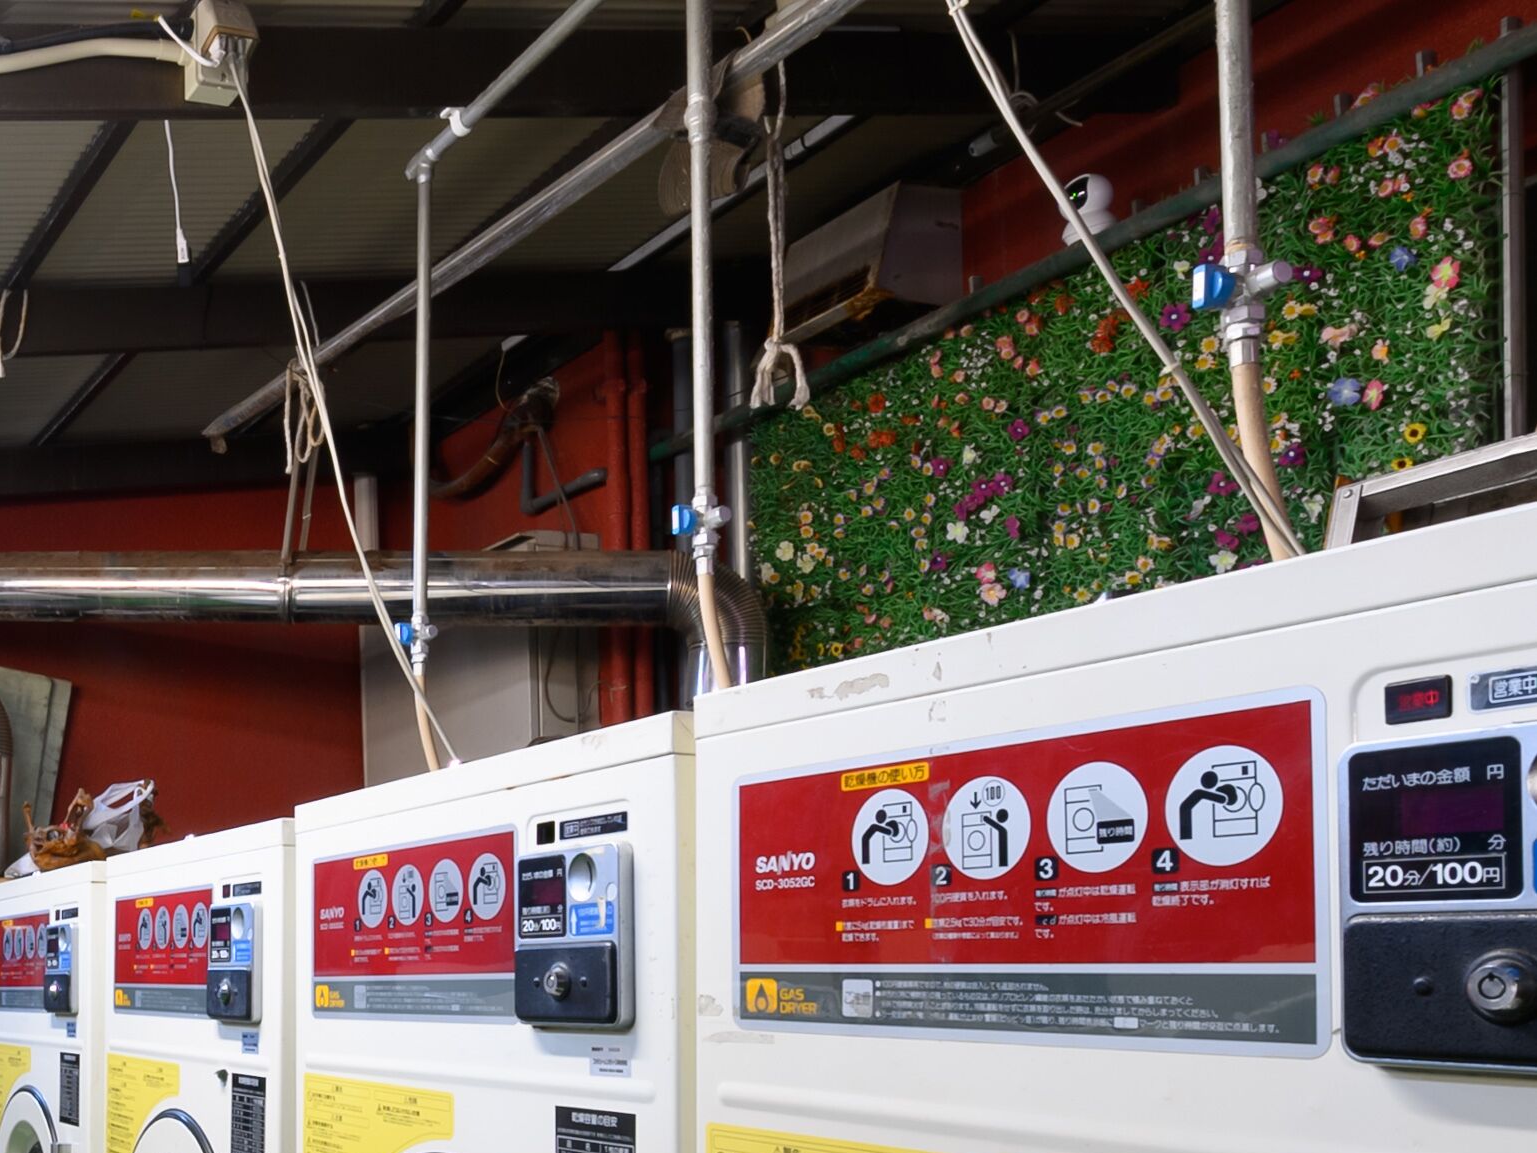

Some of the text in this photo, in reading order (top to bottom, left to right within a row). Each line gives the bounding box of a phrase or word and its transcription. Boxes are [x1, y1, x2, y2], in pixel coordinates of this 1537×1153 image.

[1492, 674, 1537, 699] 営業中
[843, 766, 926, 787] 乾燥機の使い方
[1362, 764, 1504, 791] ただいまの金額 円
[986, 785, 1002, 801] 100
[1363, 834, 1507, 857] 残り時間(約) 分
[755, 851, 815, 874] SANYO
[1039, 858, 1053, 878] 3
[1154, 850, 1173, 871] 4
[754, 876, 816, 892] SCD-3052GC
[845, 871, 855, 890] 1
[935, 866, 948, 885] 2
[1367, 861, 1502, 888] 20分/100円
[780, 988, 804, 1000] GAS
[780, 1002, 818, 1015] DRYER
